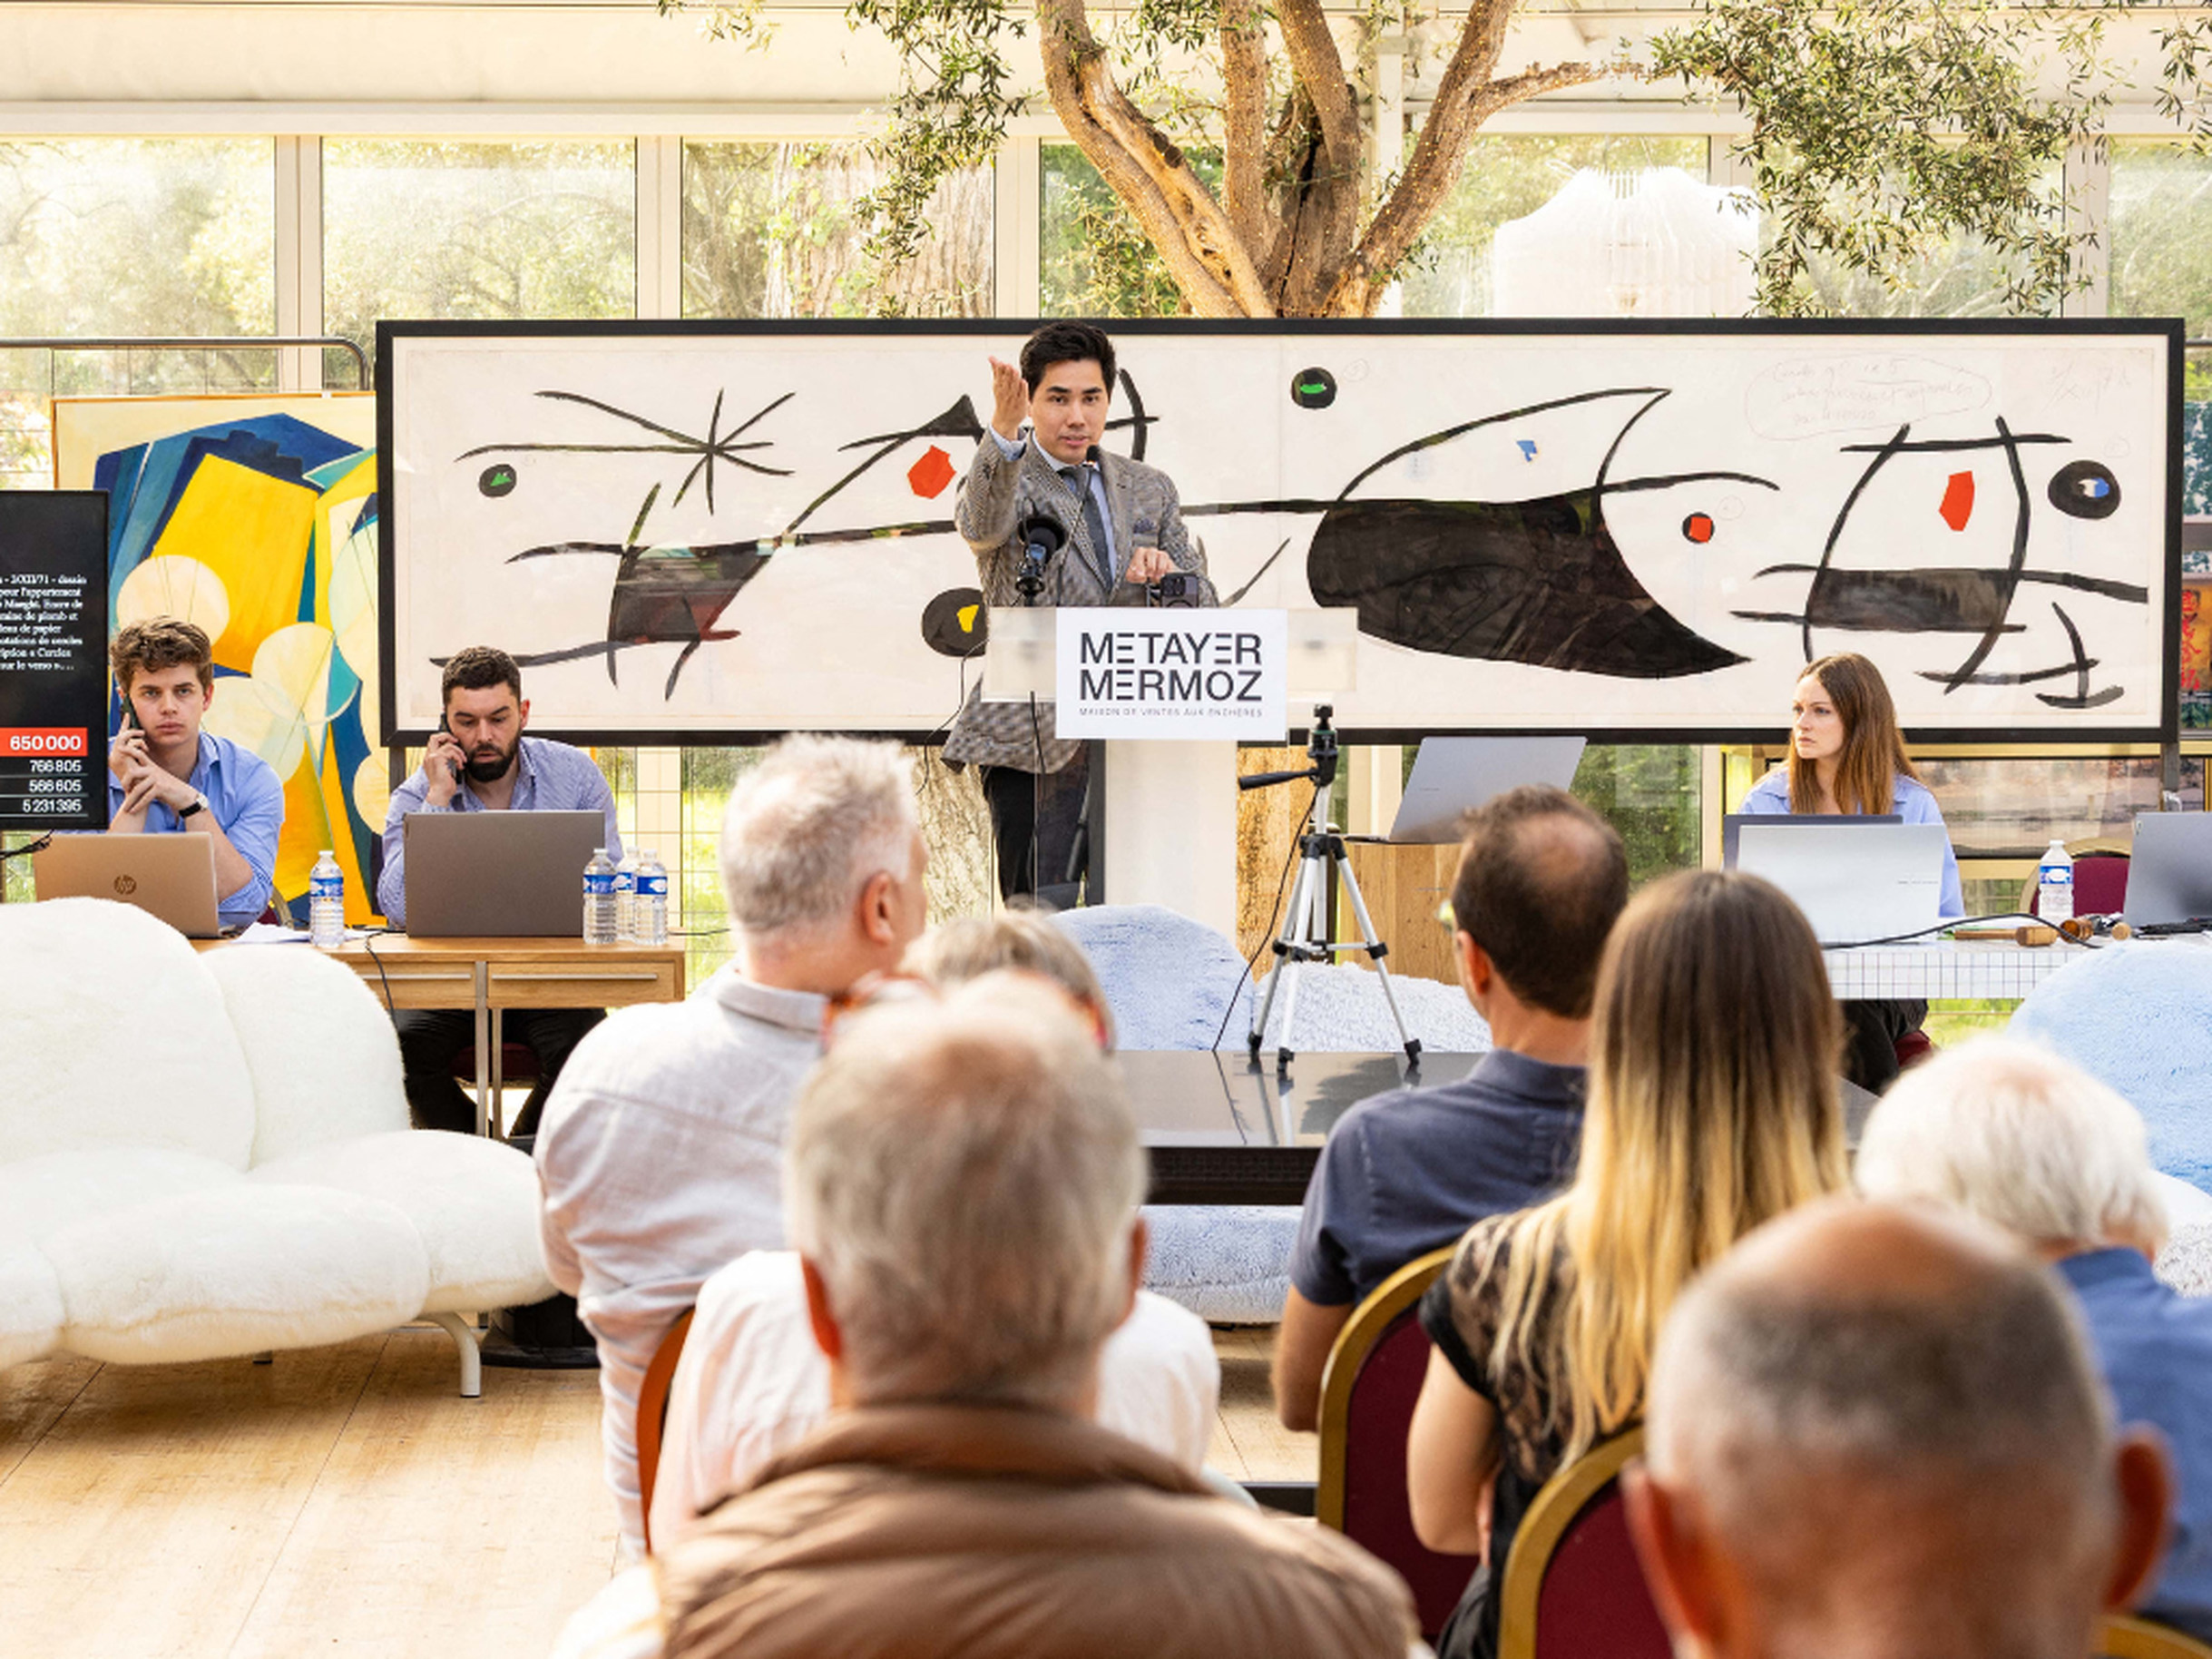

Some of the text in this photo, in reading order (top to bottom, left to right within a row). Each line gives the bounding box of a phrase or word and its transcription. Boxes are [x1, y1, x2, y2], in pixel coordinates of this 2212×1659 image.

[1081, 633, 1262, 664] METAYER
[1080, 670, 1262, 702] MERMOZ
[10, 735, 82, 751] 650 000
